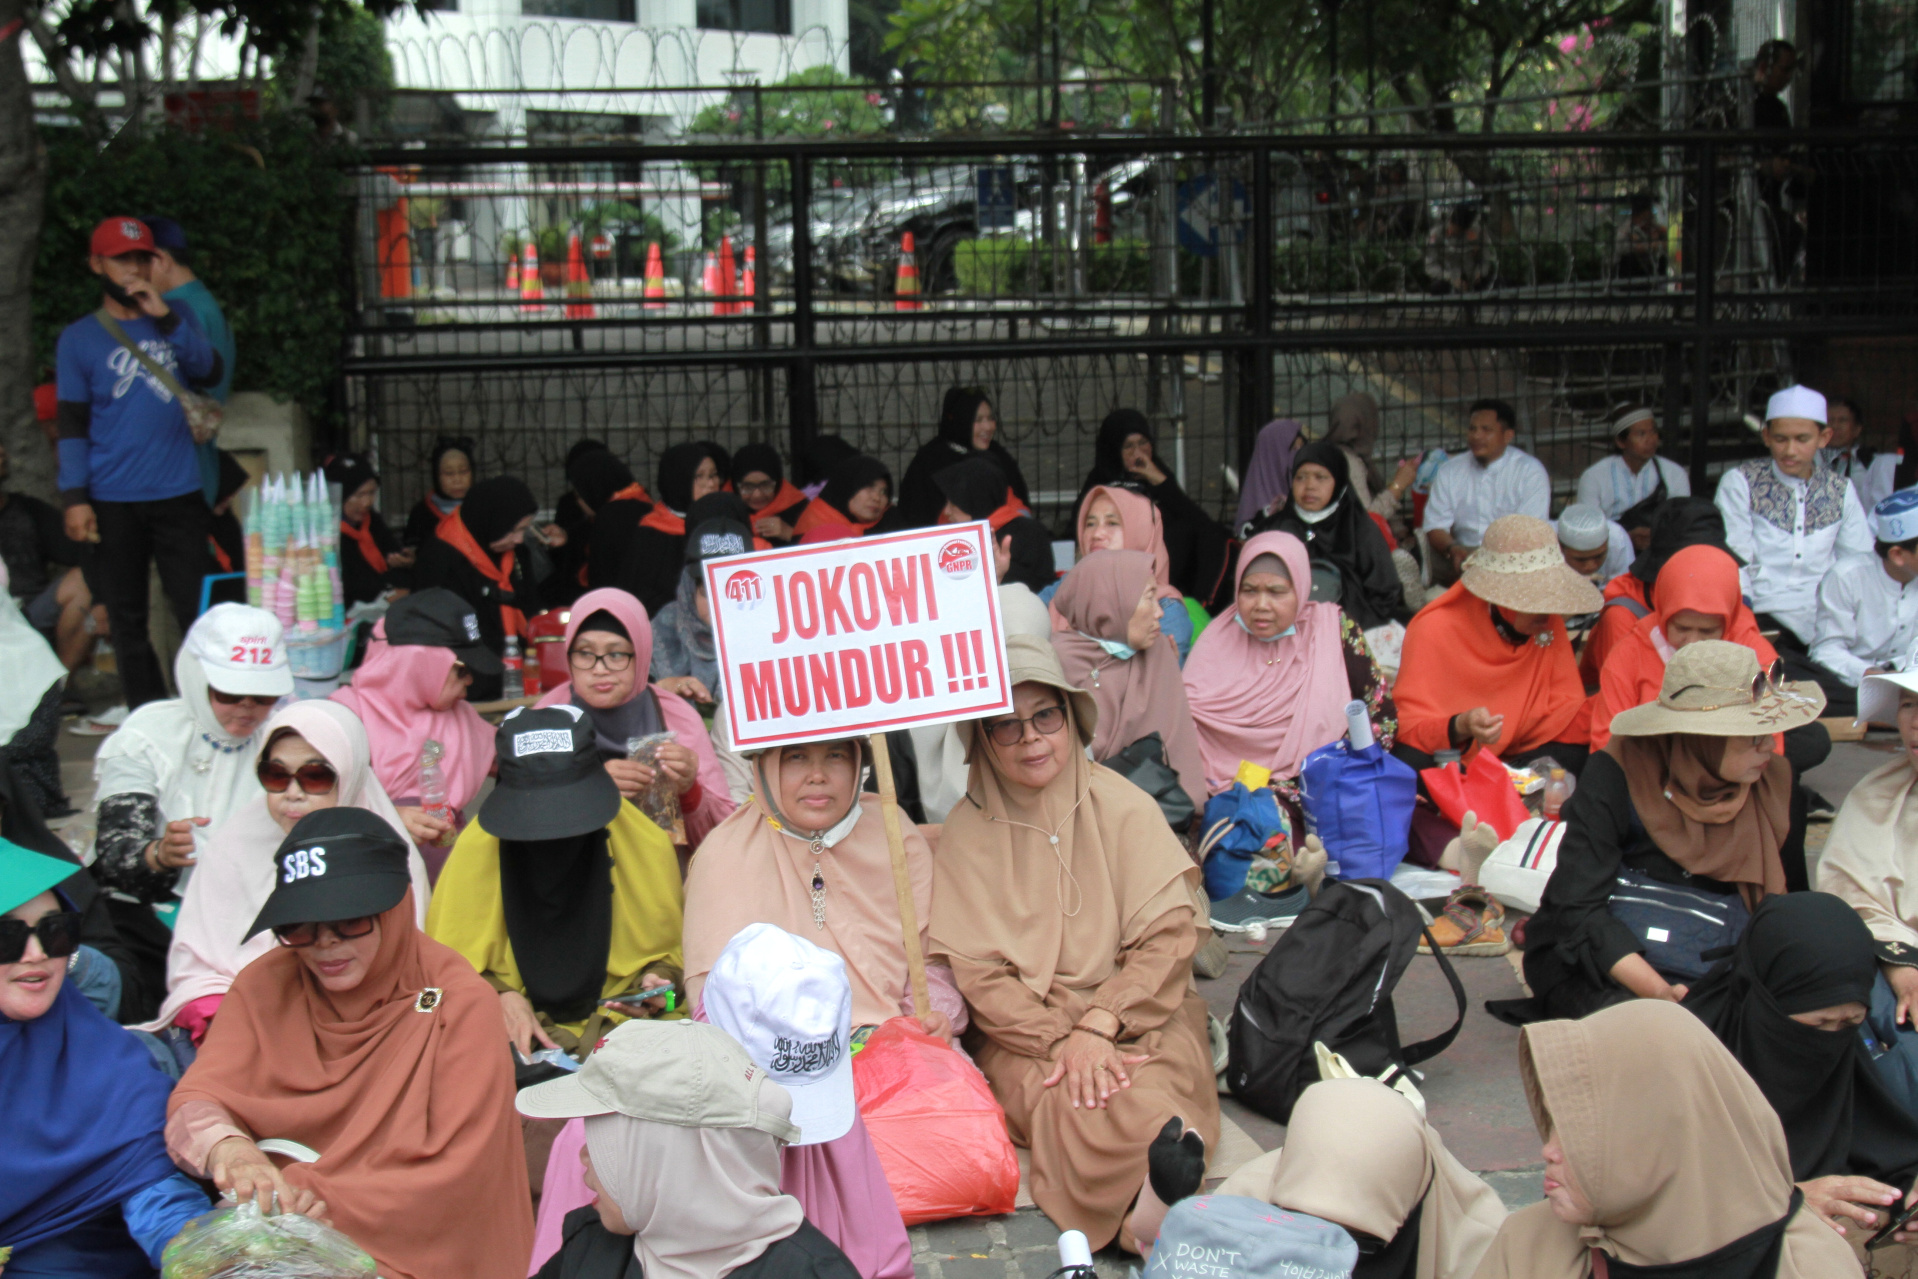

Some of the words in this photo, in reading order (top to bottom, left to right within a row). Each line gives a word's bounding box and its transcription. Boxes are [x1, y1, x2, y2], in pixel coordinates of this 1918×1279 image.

[946, 559, 973, 573] GNPR
[730, 577, 762, 603] 411
[772, 553, 939, 644] JOKOWI
[231, 646, 273, 664] 212
[739, 639, 935, 722] MUNDUR
[940, 629, 989, 694] !!!
[283, 846, 327, 883] SBS
[1176, 1243, 1241, 1265] DON'T
[1175, 1259, 1230, 1278] WASTE
